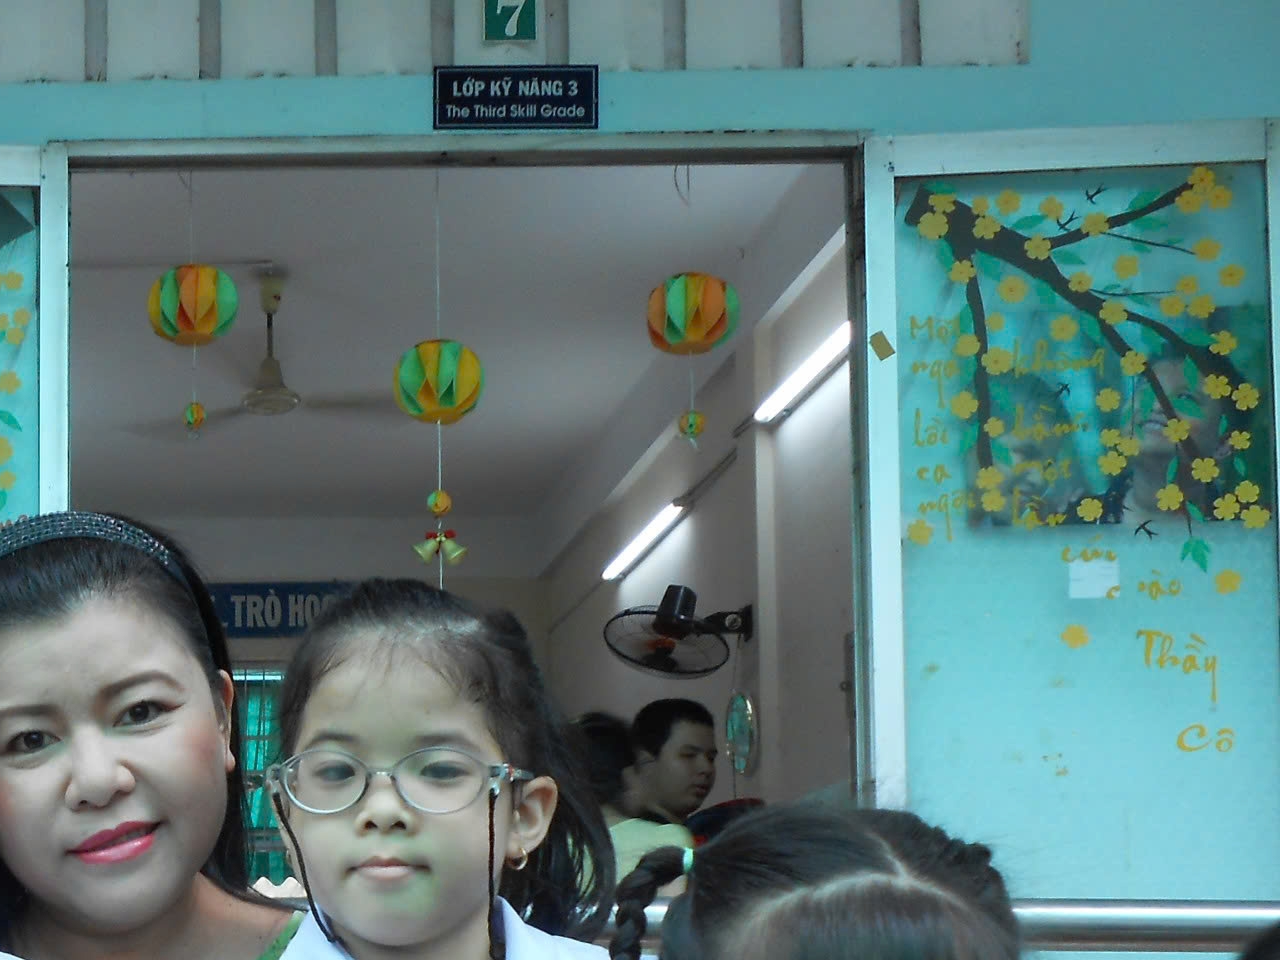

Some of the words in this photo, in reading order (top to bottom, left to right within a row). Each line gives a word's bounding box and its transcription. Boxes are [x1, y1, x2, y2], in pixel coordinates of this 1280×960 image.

[496, 0, 528, 37] 7
[452, 76, 486, 97] LỚP
[489, 76, 512, 97] KỸ
[518, 76, 563, 97] NĂNG
[568, 80, 579, 96] 3
[445, 104, 470, 118] The
[473, 104, 507, 118] Third
[510, 104, 537, 118] Skill
[540, 104, 586, 118] Grade
[916, 463, 952, 484] ca
[230, 588, 283, 628] TRÒ
[1136, 629, 1219, 704] Thầy
[1176, 723, 1236, 753] Cô
